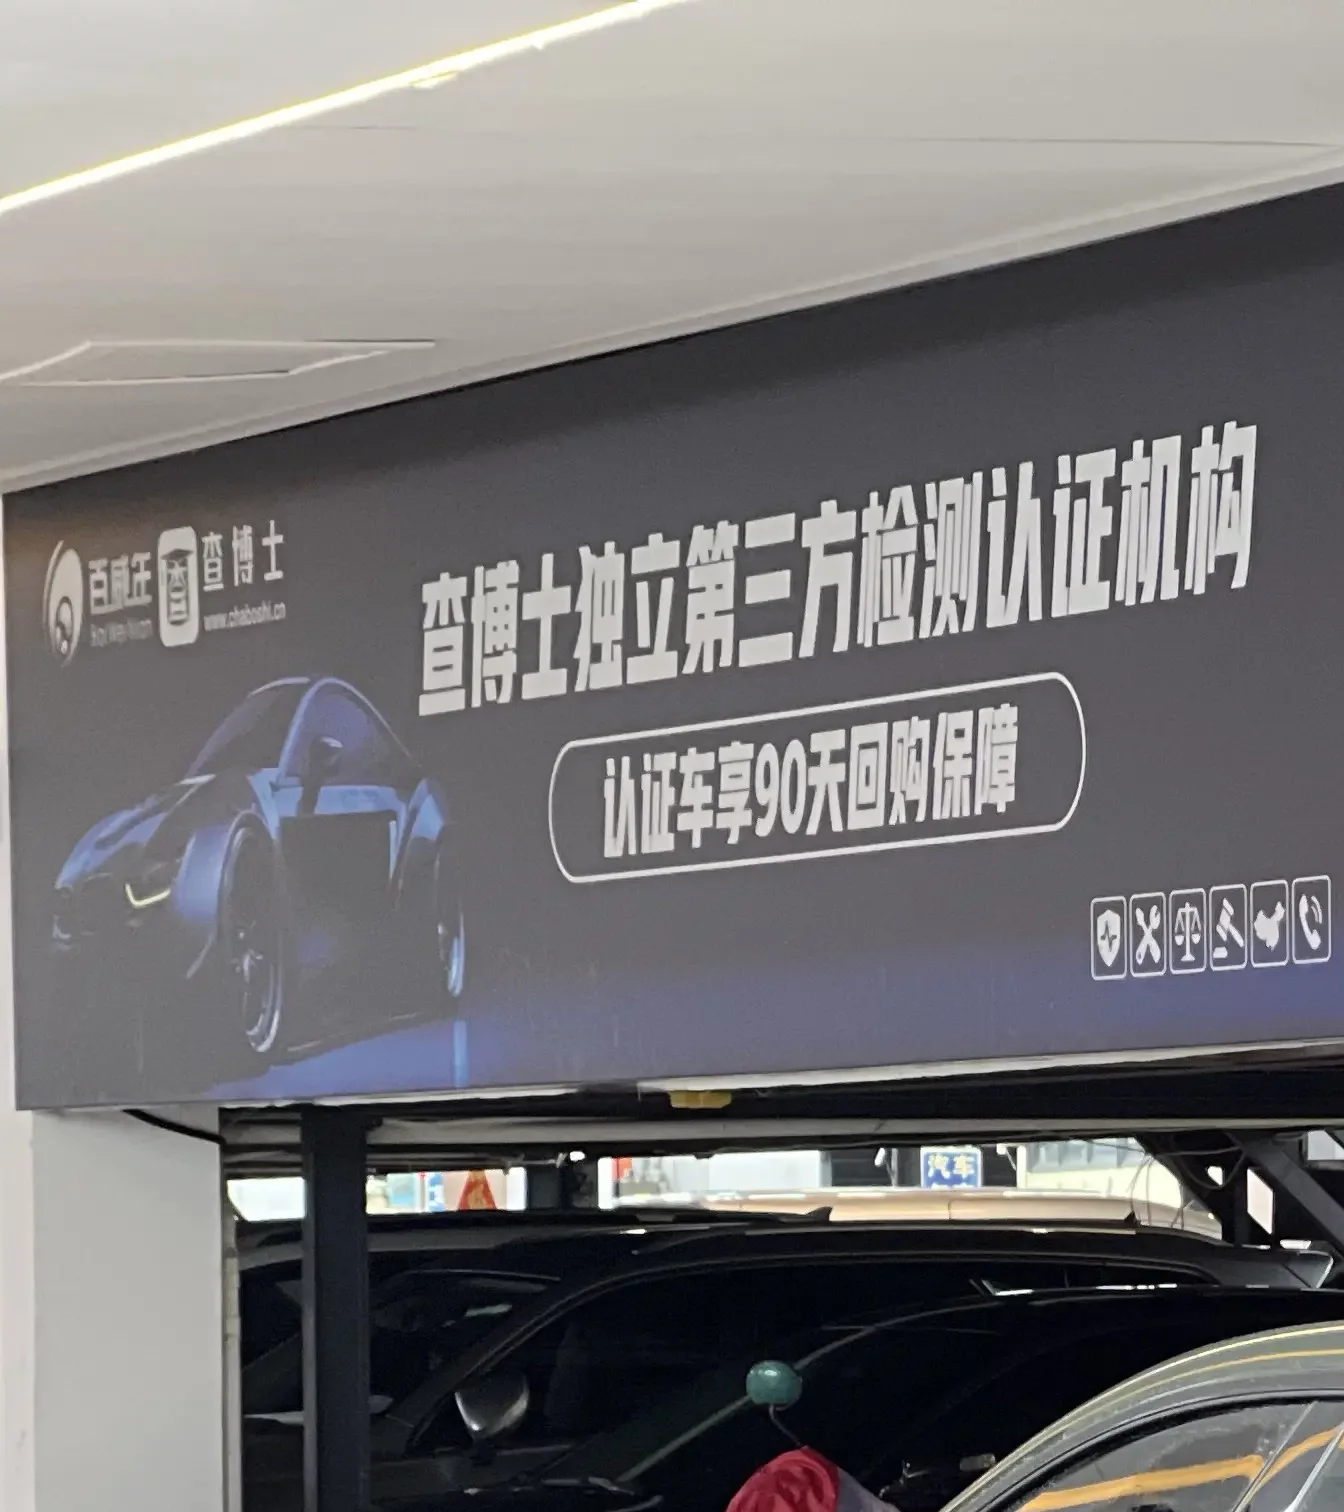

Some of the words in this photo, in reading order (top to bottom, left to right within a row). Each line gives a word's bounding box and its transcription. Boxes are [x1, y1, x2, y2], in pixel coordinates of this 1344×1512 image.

[201, 519, 285, 592] 查博士
[418, 420, 1258, 717] 查博士独立第三方检测认证机构
[603, 702, 1019, 860] 认证车享90天回购保障
